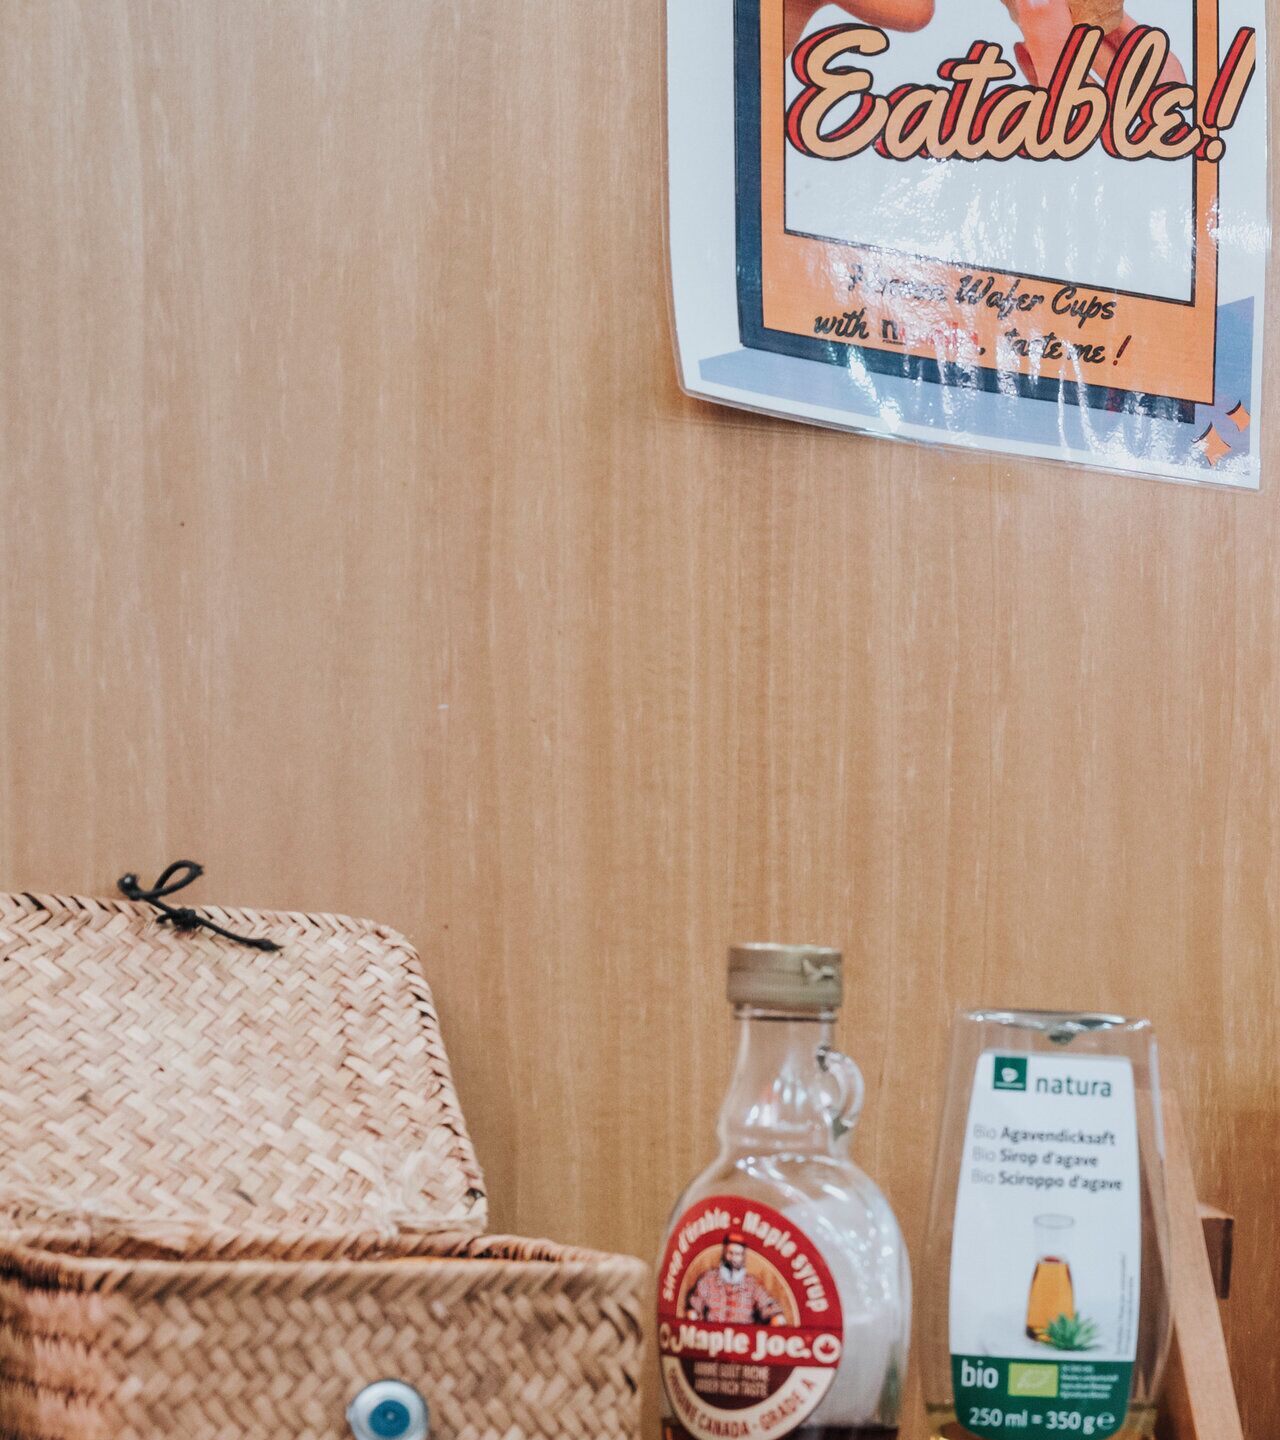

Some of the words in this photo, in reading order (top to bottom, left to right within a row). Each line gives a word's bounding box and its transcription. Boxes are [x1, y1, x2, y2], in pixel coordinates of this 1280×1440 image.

[785, 23, 1256, 161] Eatable!
[955, 275, 1044, 320] Wafer
[1051, 286, 1117, 328] Cups
[814, 307, 869, 339] with
[1004, 328, 1062, 359] tate
[1035, 1076, 1112, 1098] natura
[1001, 1127, 1116, 1146] Agavendicksaft
[1000, 1149, 1038, 1165] Sirop
[999, 1171, 1064, 1189] Sciroppo
[742, 1210, 797, 1258] Maple
[790, 1252, 829, 1313] syrup
[670, 1323, 749, 1358] Maple
[960, 1359, 999, 1389] bio
[697, 1414, 750, 1439] CANADA
[968, 1407, 1003, 1428] 250
[1005, 1410, 1028, 1428] ml
[1046, 1411, 1081, 1431] 350
